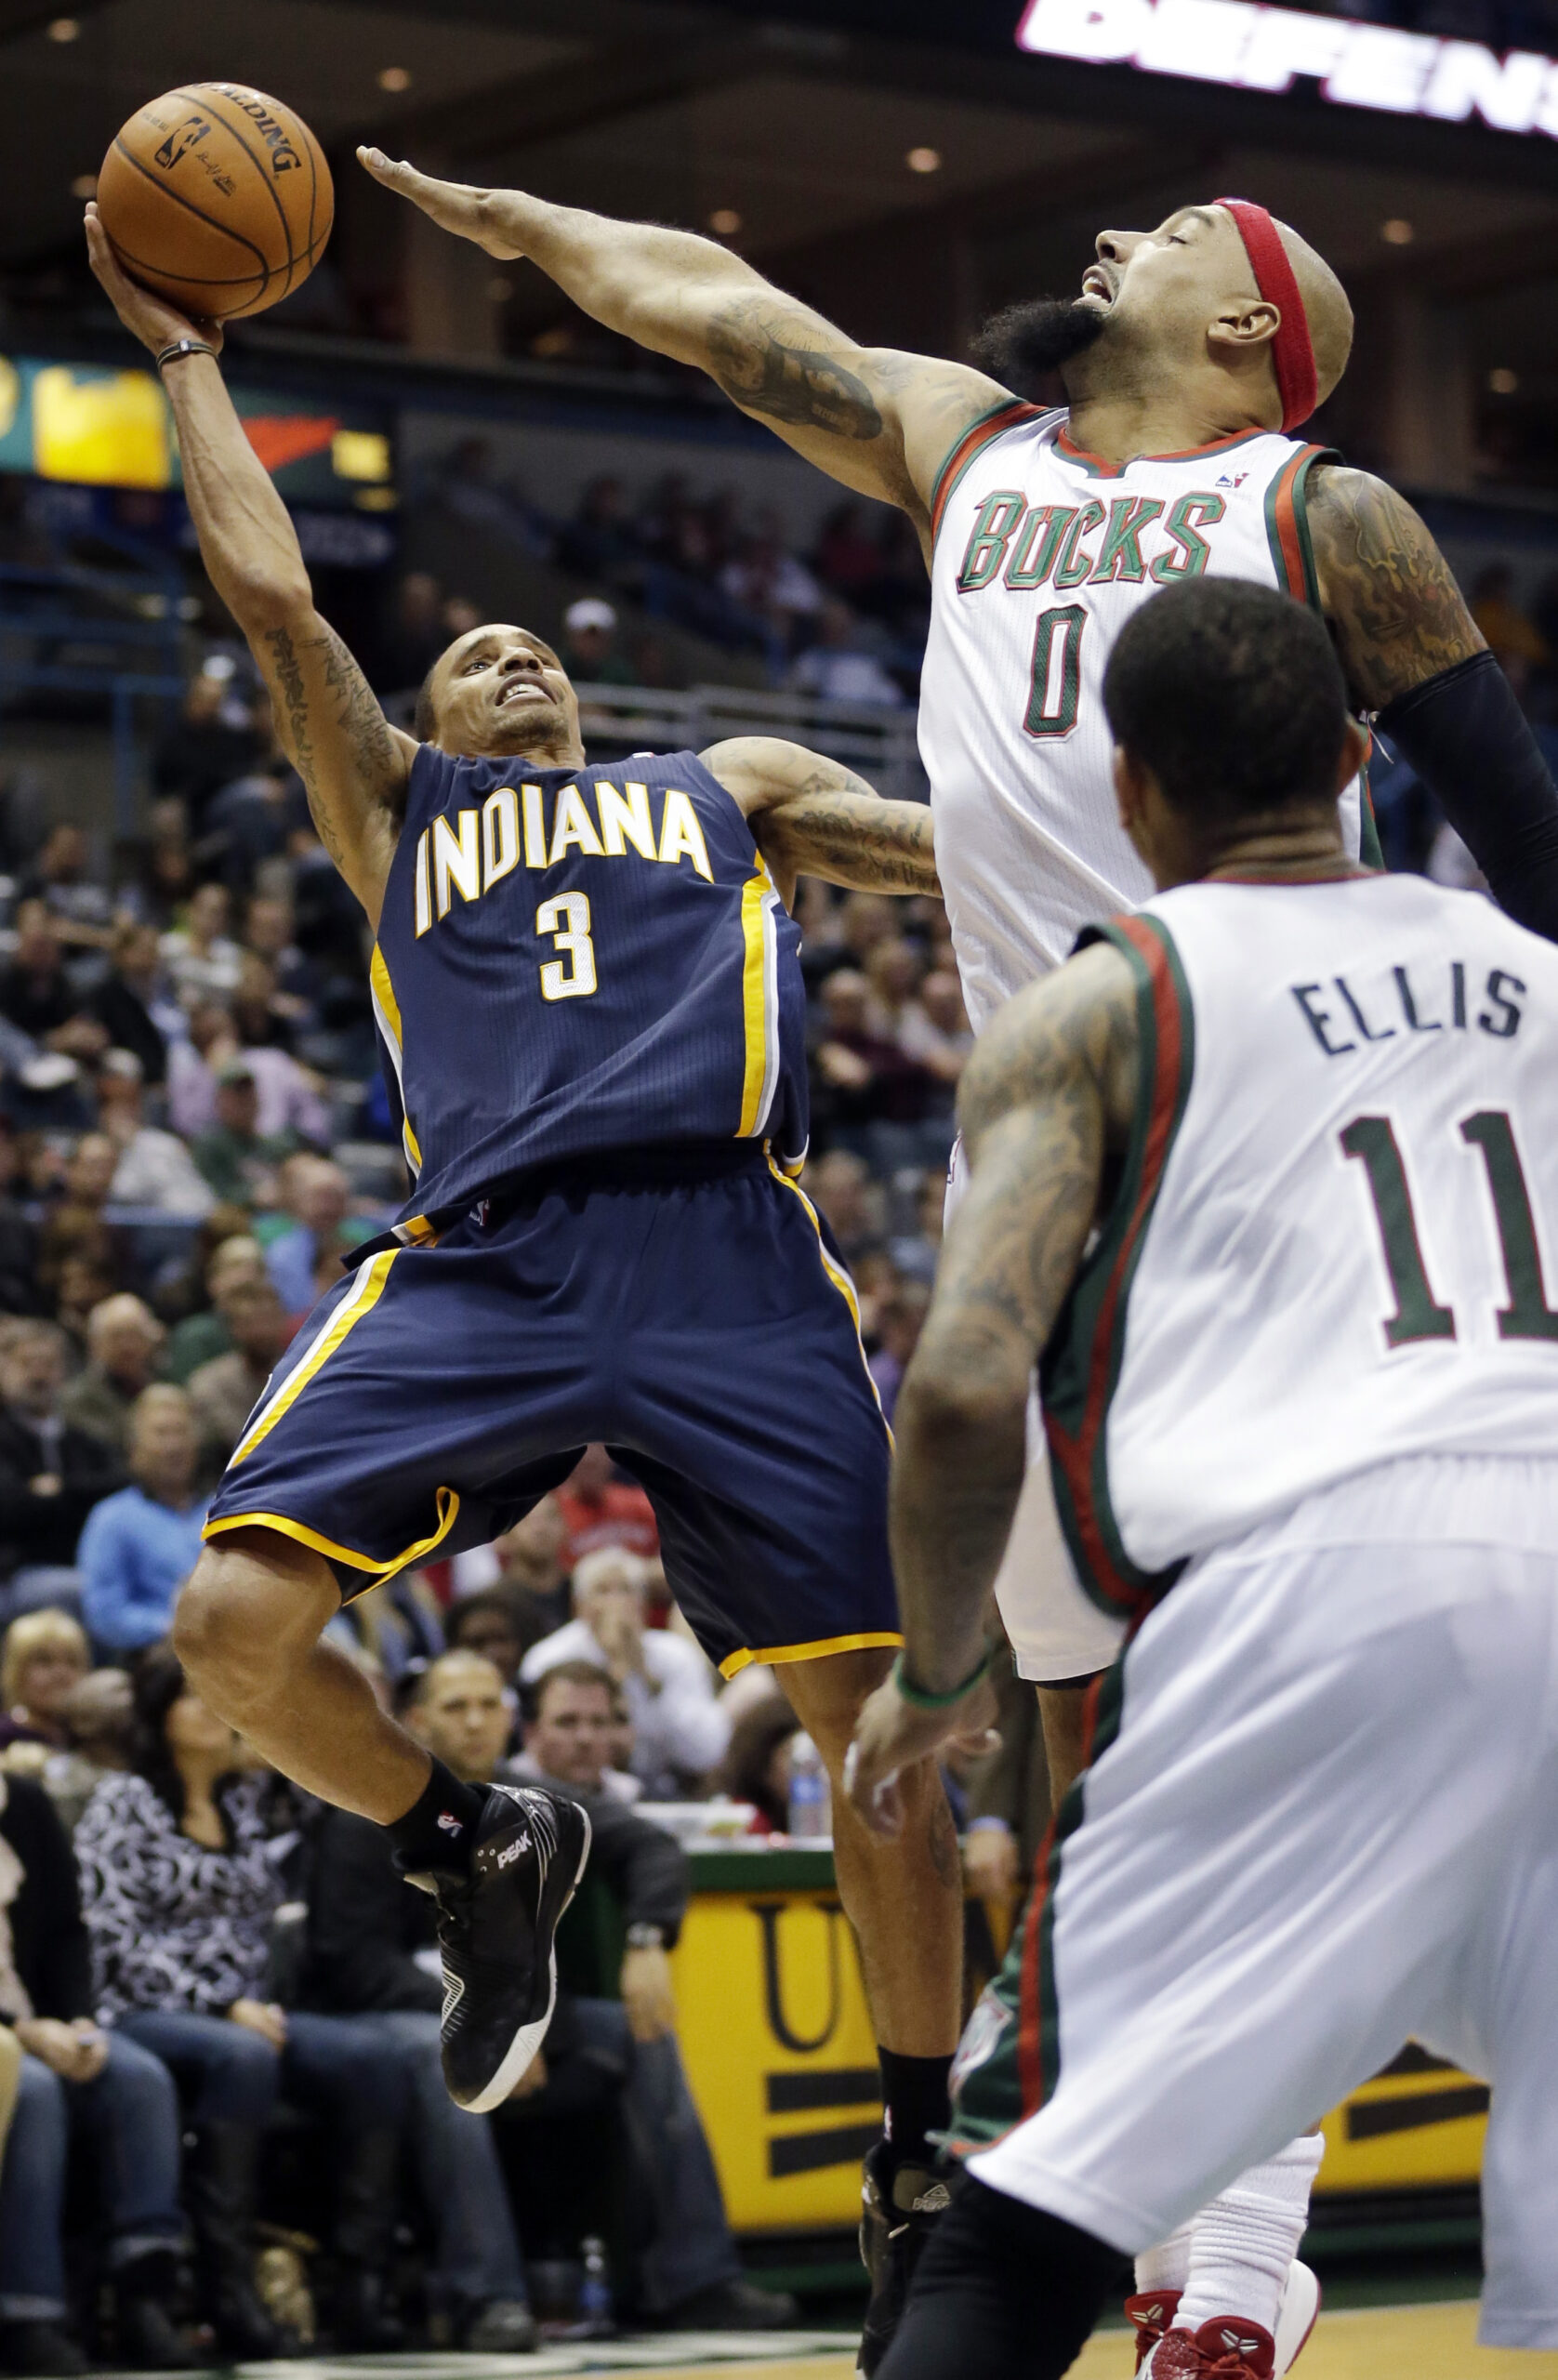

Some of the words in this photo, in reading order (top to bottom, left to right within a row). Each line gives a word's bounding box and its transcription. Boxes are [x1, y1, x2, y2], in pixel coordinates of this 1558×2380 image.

[1016, 0, 1558, 137] DEFEN
[956, 489, 1227, 594] BUCKS
[1022, 602, 1089, 738] 0
[415, 781, 715, 941] INDIANA
[536, 890, 598, 1002] 3
[1290, 962, 1526, 1057] ELLIS
[1339, 1110, 1558, 1350] 11
[496, 1829, 533, 1871] PEAK
